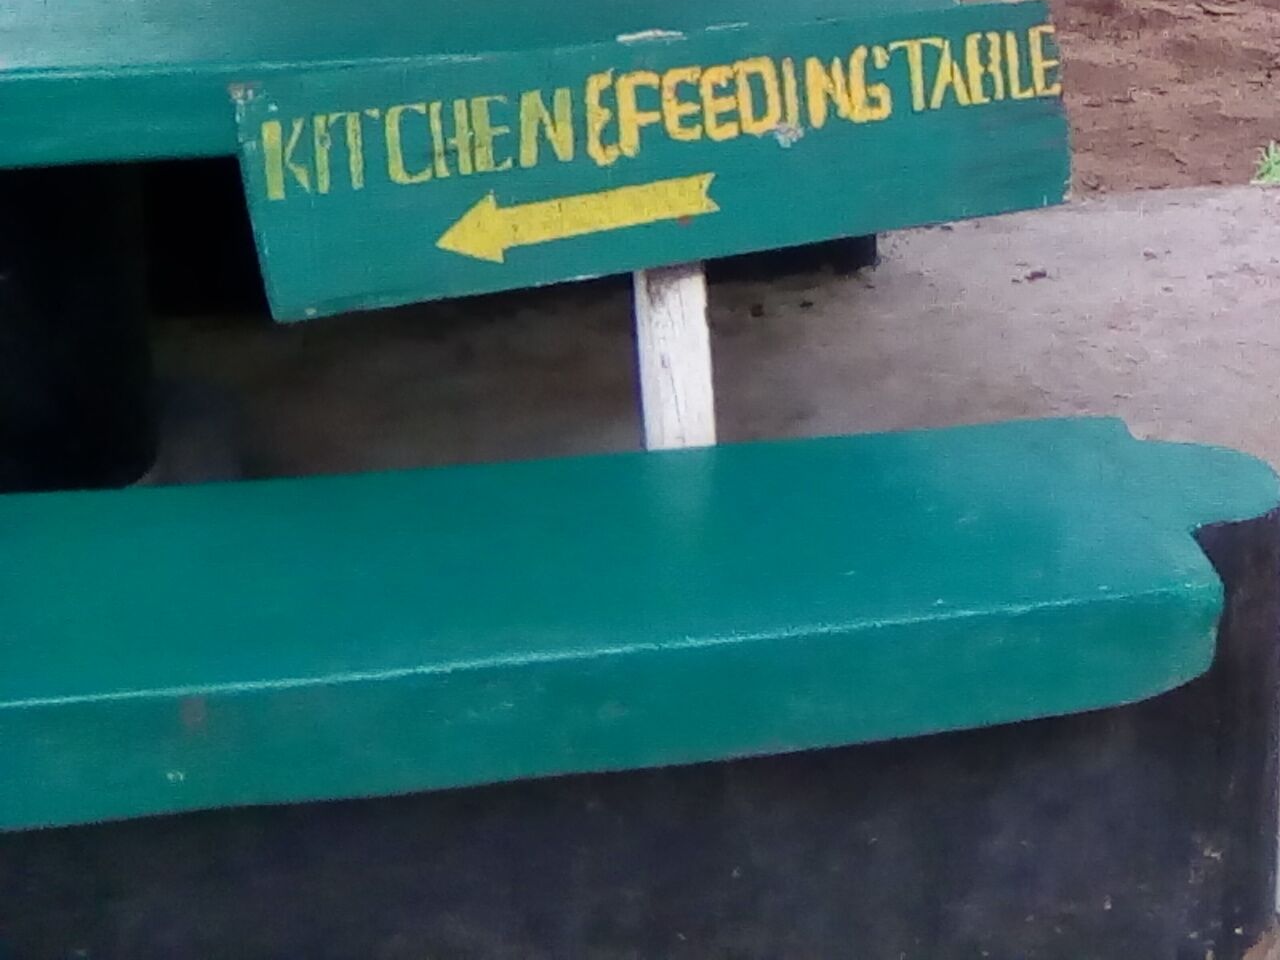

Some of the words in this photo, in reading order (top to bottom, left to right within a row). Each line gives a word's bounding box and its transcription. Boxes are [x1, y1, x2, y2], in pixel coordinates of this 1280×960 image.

[261, 87, 574, 201] KITCHEN
[615, 45, 892, 159] FEEDING
[888, 25, 1062, 112] TABLE
